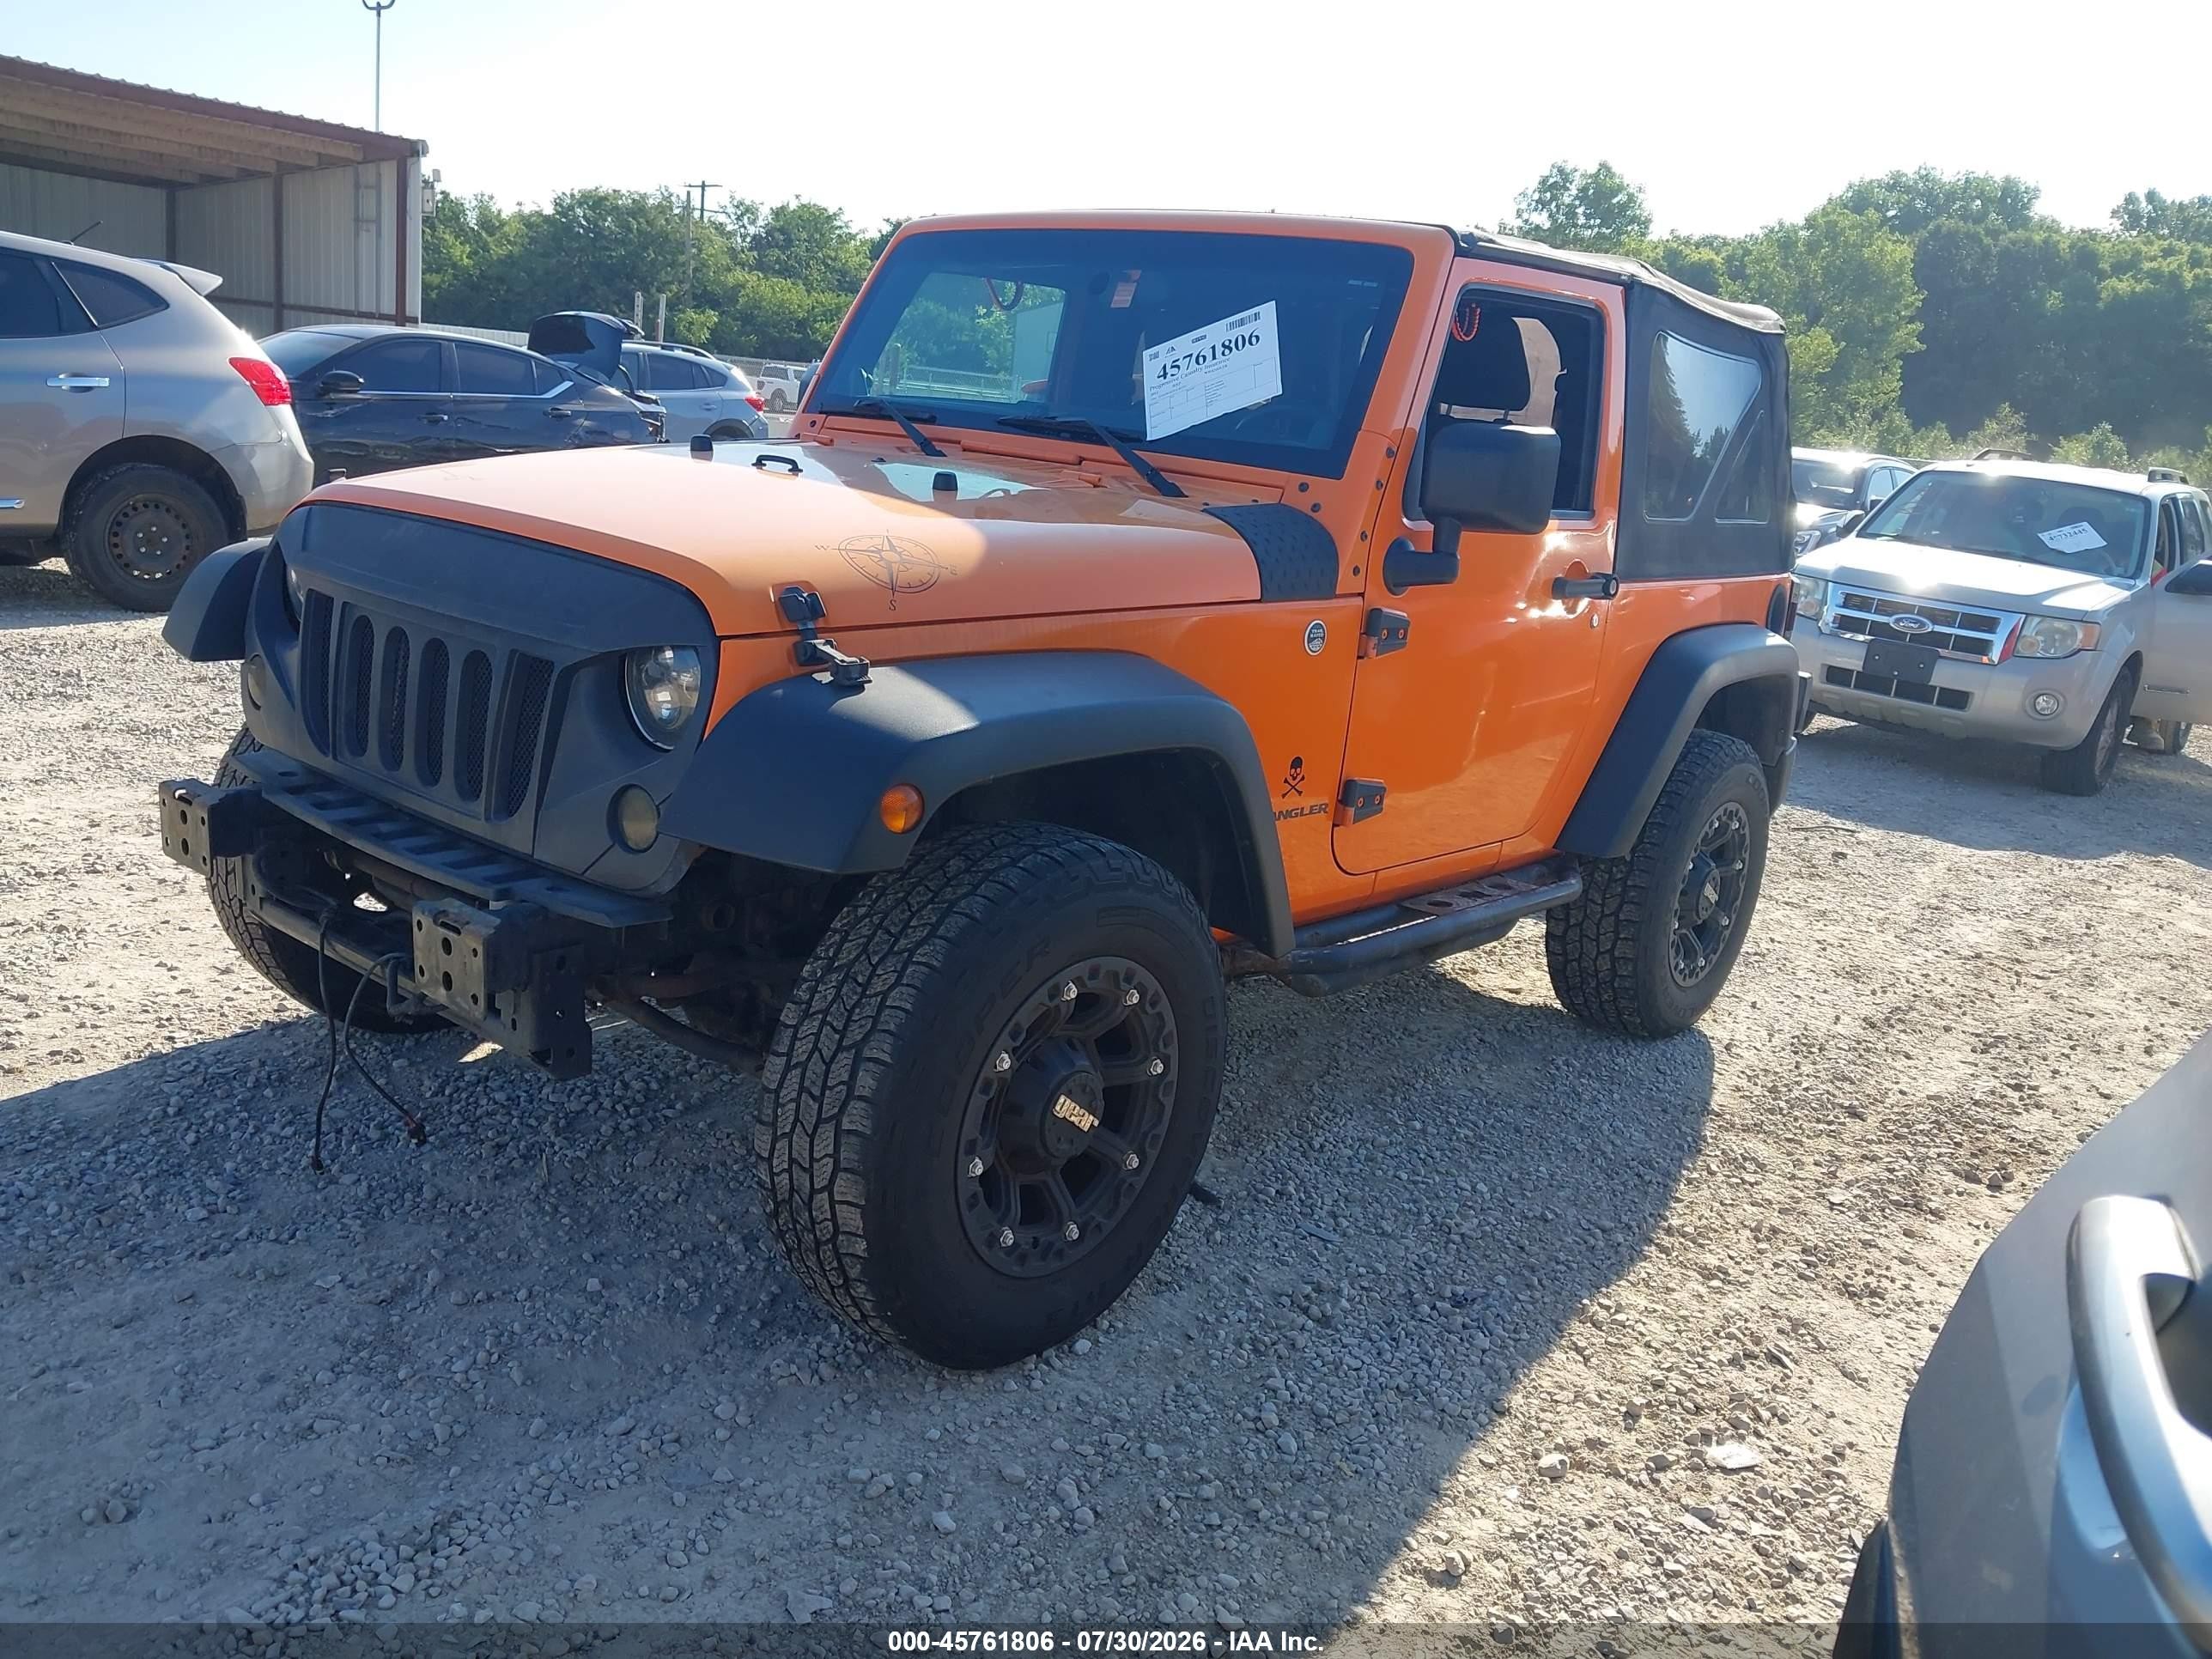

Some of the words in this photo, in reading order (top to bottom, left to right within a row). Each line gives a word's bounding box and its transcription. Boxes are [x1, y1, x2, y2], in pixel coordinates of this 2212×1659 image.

[1157, 328, 1261, 380] 45761806
[1180, 367, 1204, 380] Casualty
[888, 599, 897, 611] S
[1052, 1093, 1100, 1133] gear
